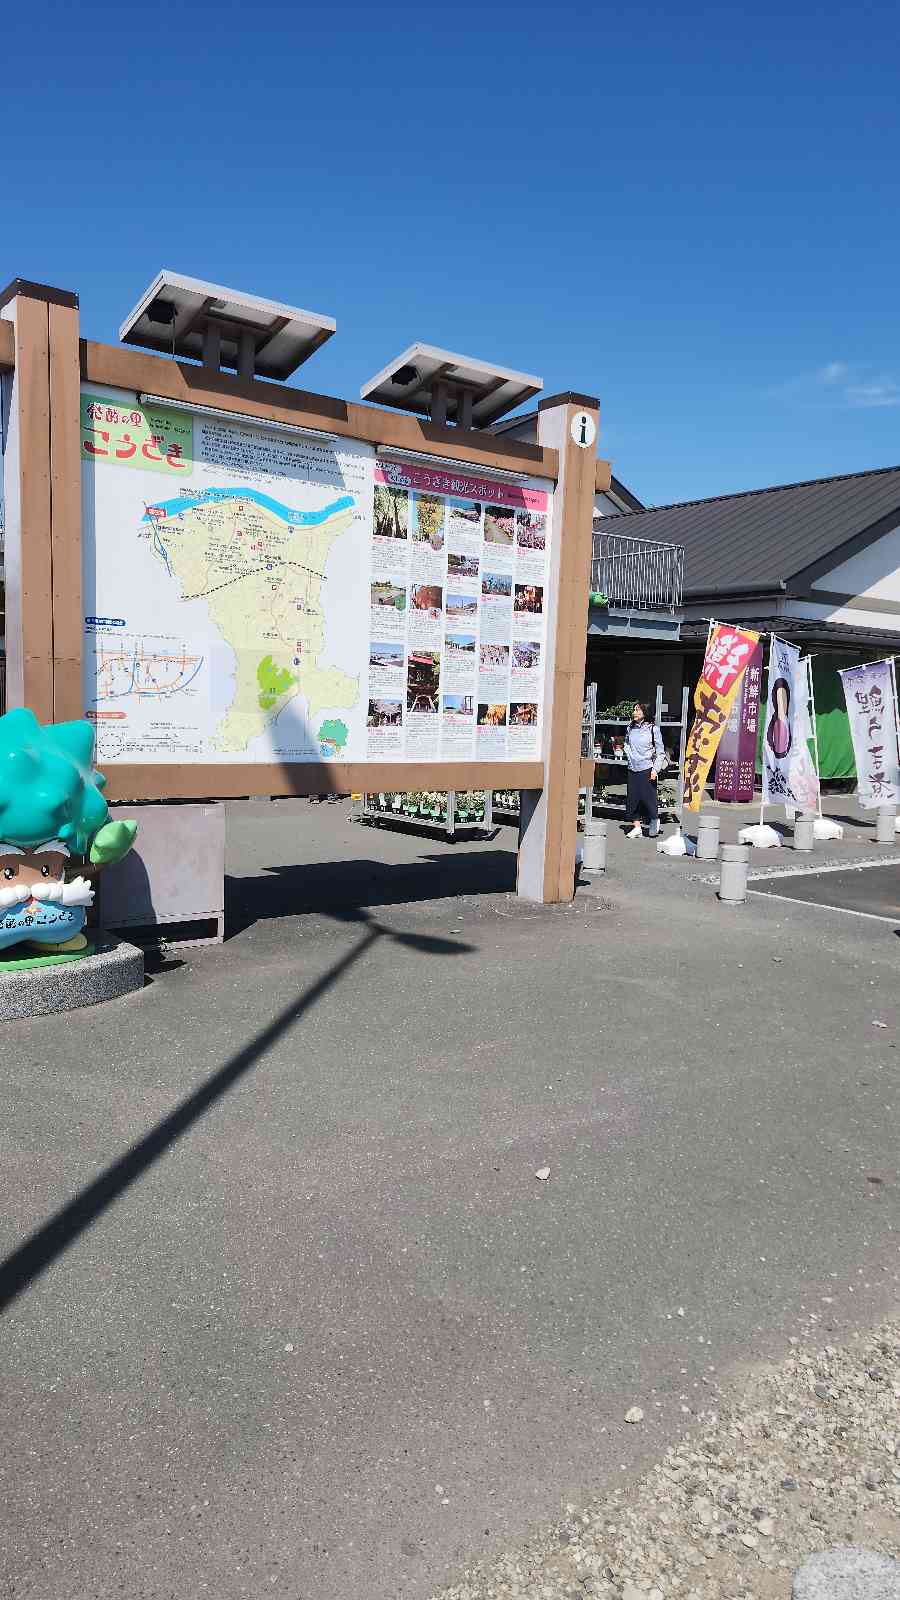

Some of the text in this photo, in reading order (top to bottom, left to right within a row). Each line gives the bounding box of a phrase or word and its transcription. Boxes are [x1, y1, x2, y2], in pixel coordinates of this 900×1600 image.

[83, 426, 186, 469] こうざき
[413, 471, 504, 499] こうざき観光スポット
[747, 667, 760, 733] 新鮮市場
